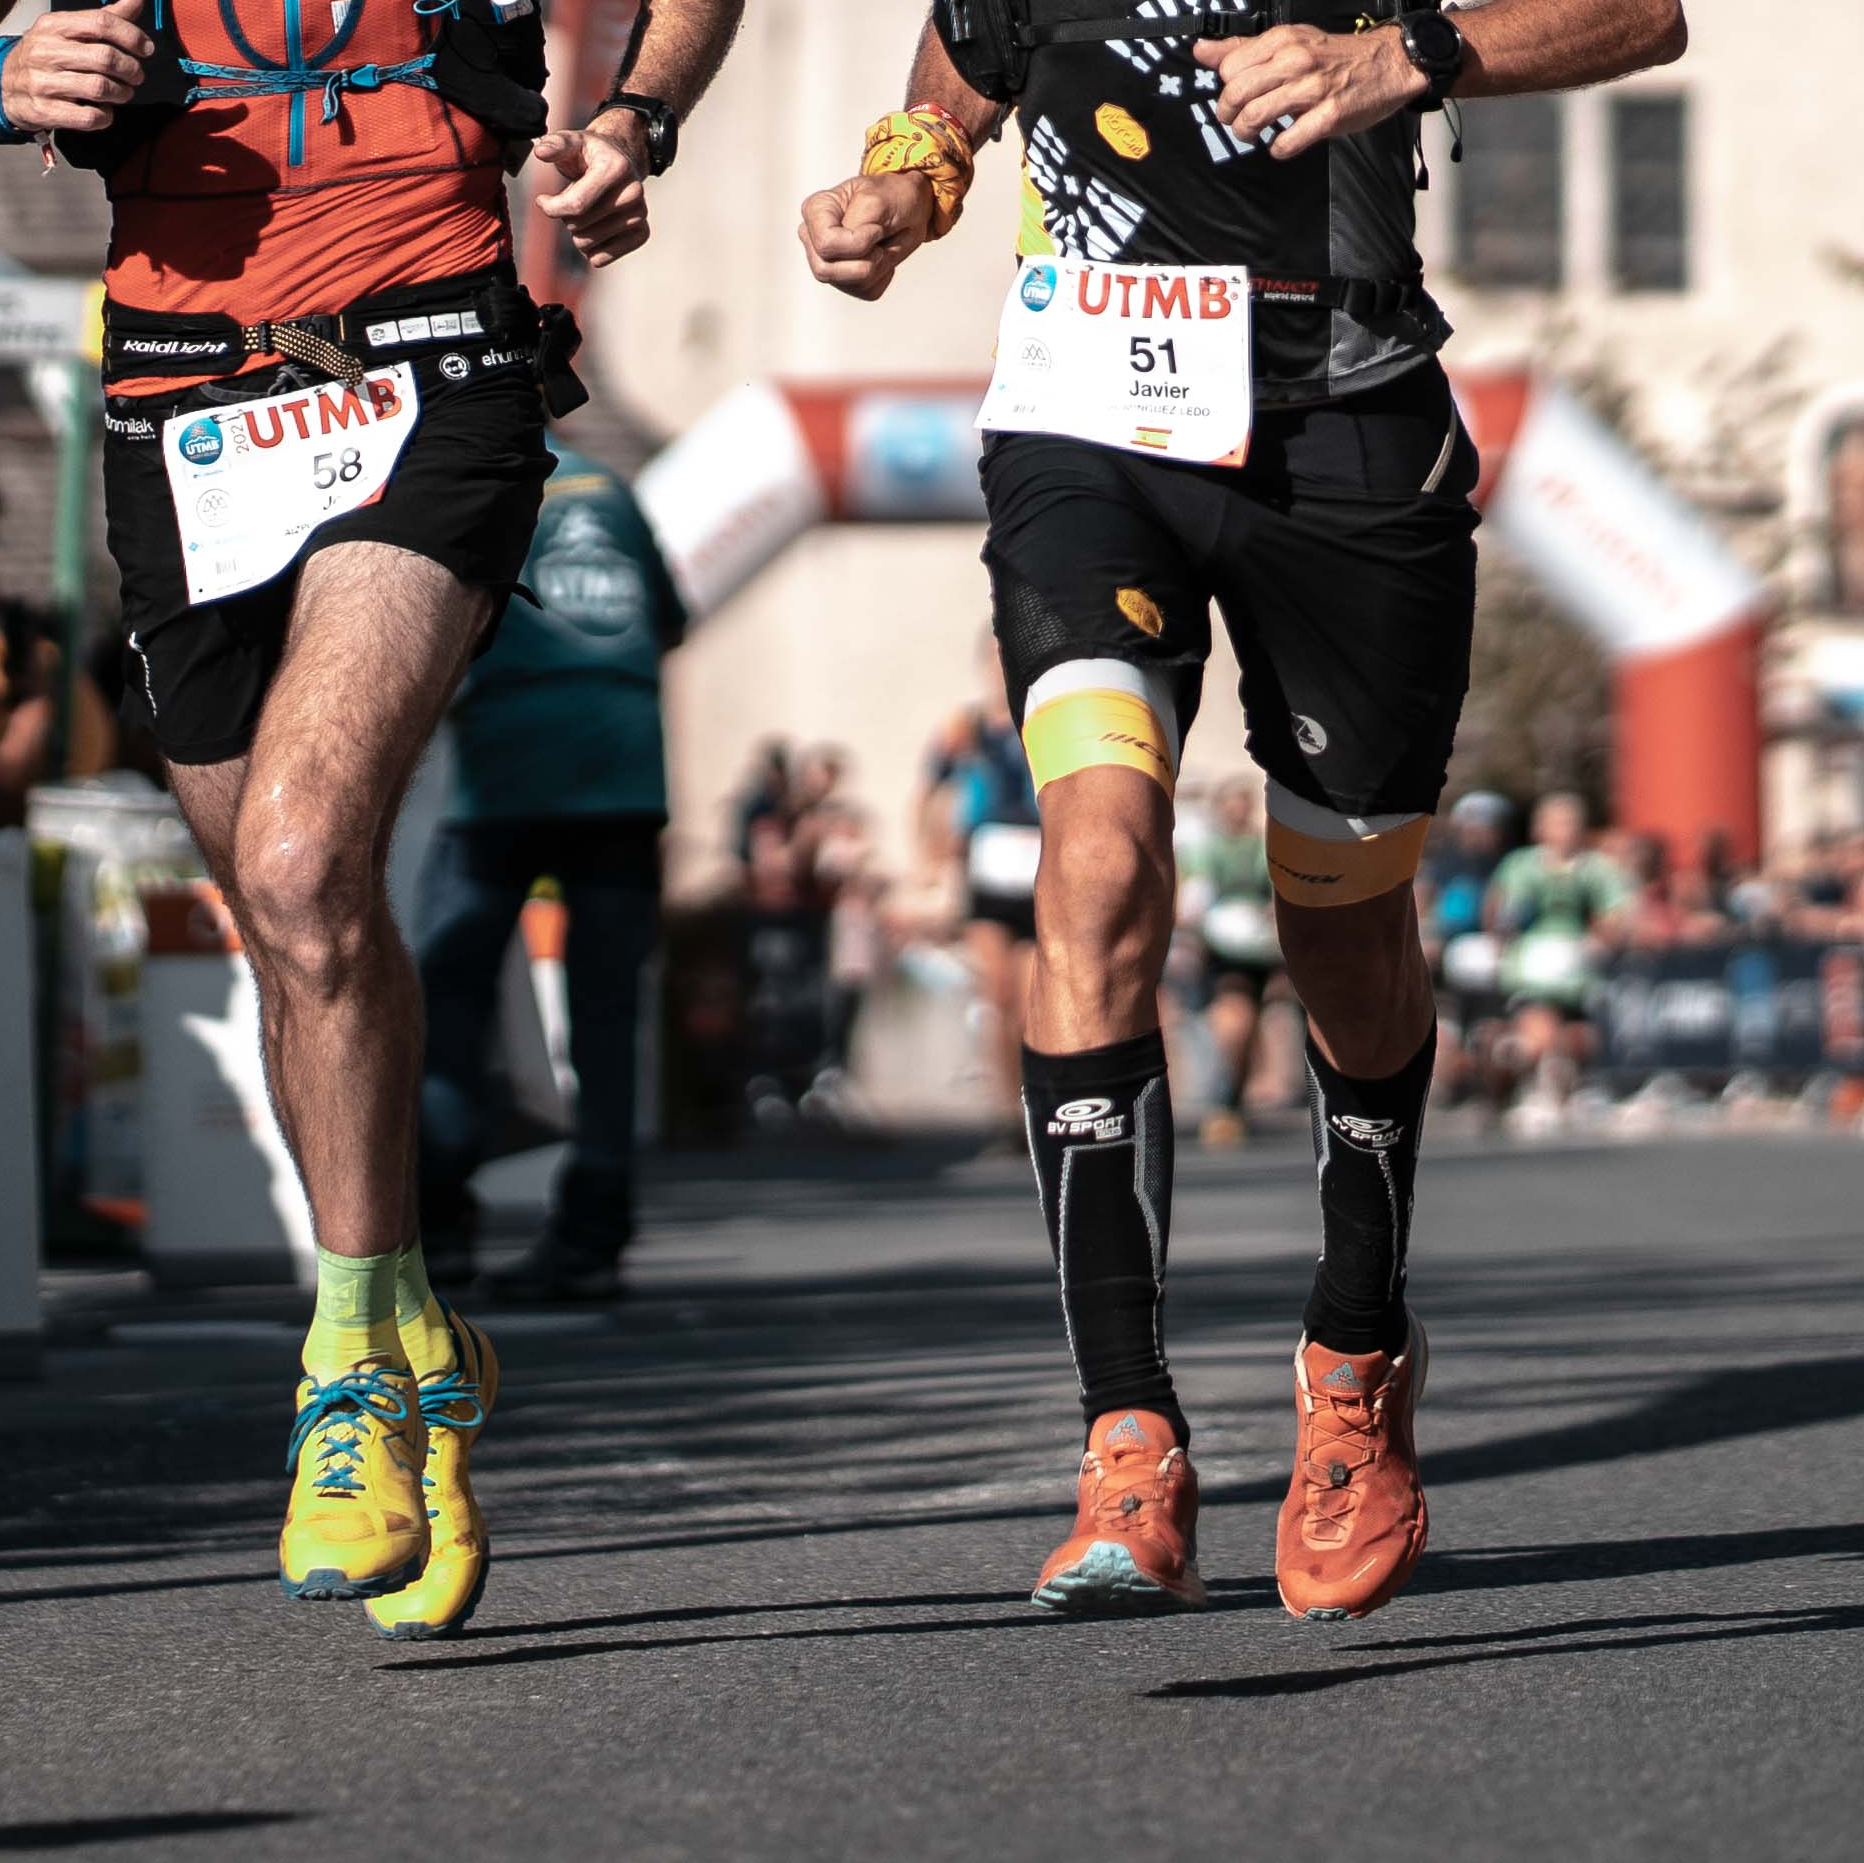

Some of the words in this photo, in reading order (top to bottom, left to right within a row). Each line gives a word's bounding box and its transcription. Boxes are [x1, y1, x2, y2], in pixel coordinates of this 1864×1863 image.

[1077, 271, 1233, 320] UTMB
[1129, 336, 1177, 374] 51
[1129, 379, 1190, 399] Javier
[244, 378, 403, 449] UTMB
[185, 439, 221, 456] UTMB
[313, 447, 363, 490] 58
[1069, 1114, 1125, 1135] SPORT
